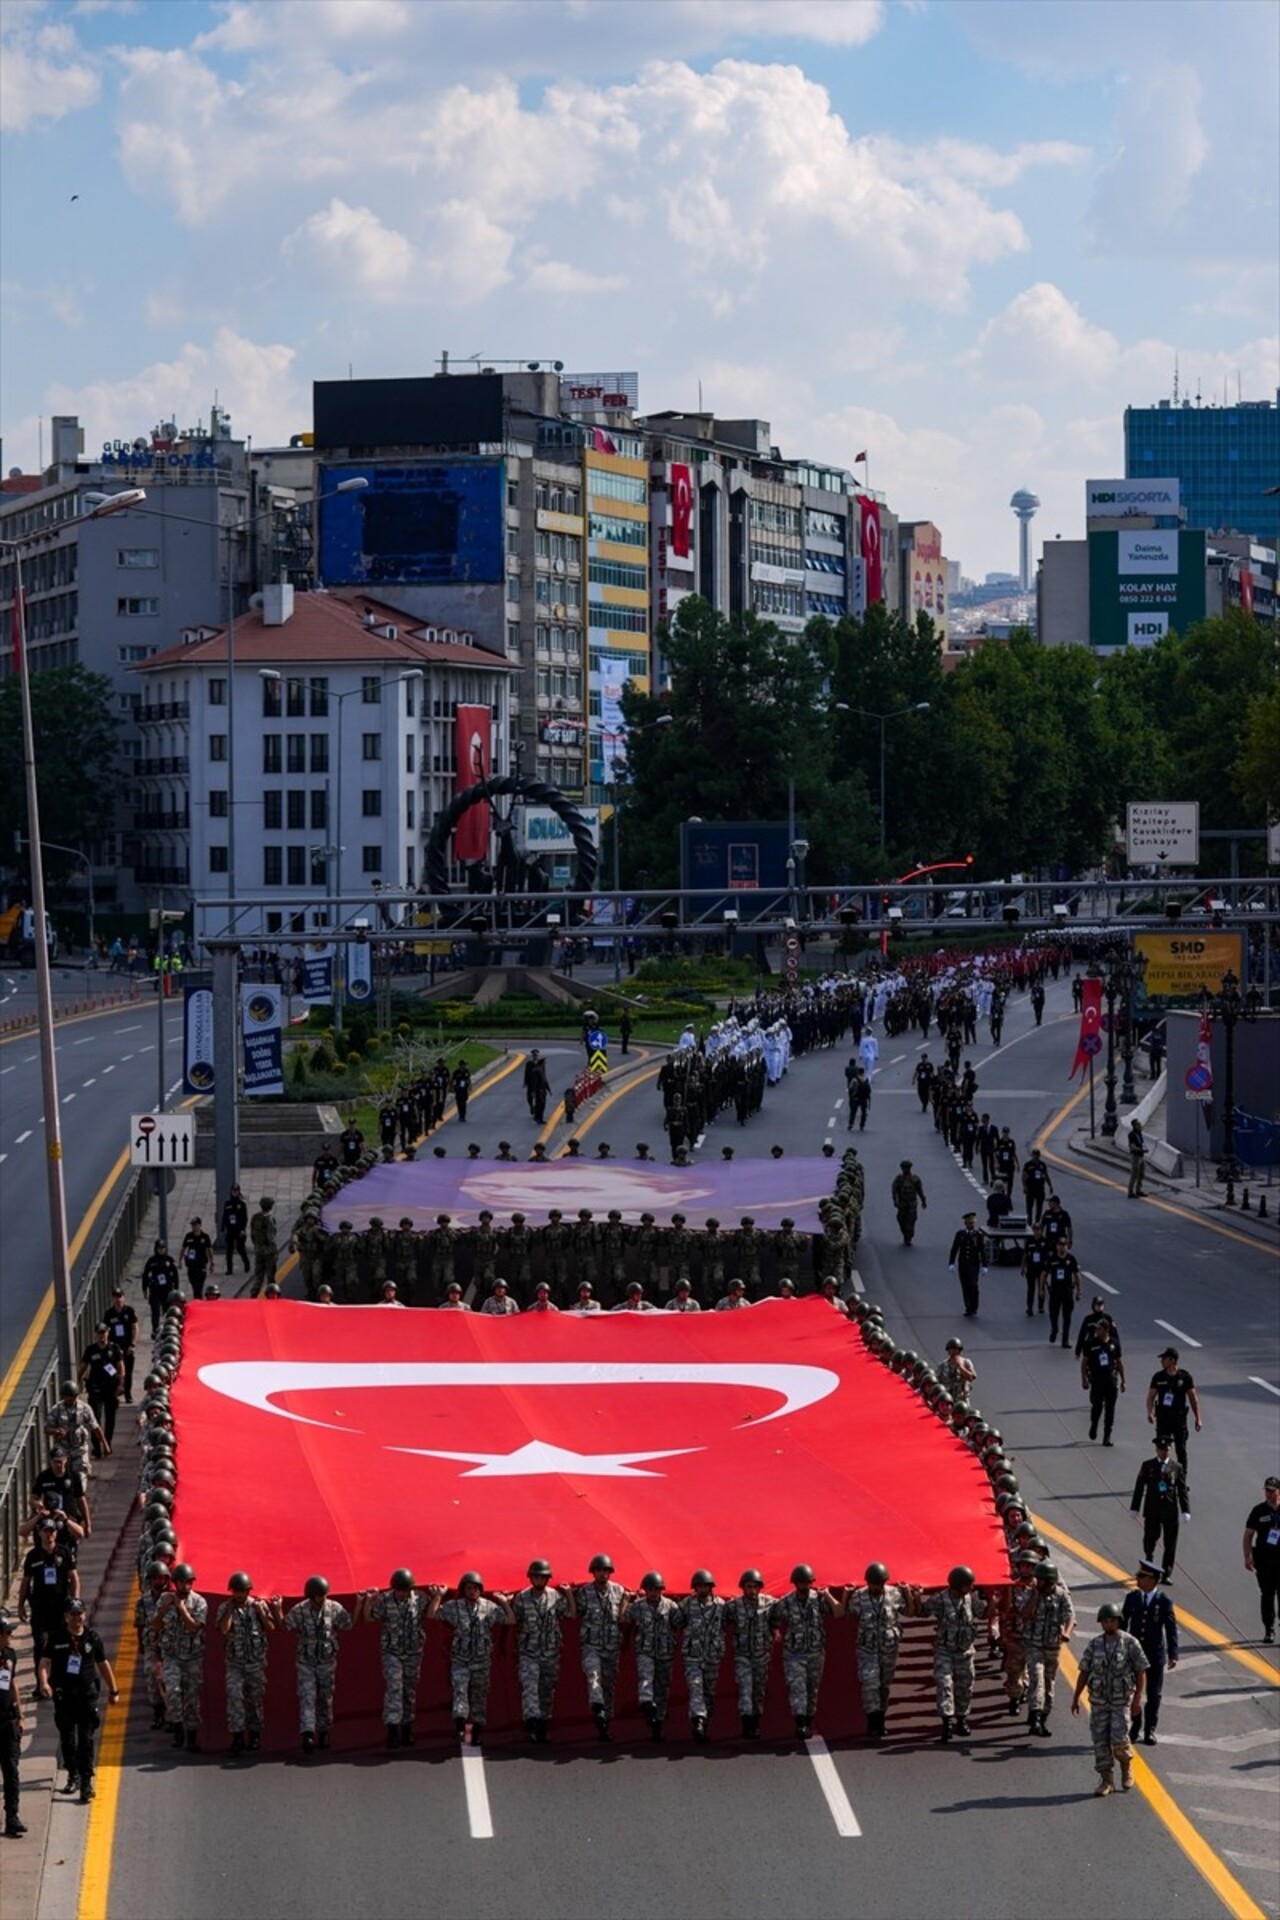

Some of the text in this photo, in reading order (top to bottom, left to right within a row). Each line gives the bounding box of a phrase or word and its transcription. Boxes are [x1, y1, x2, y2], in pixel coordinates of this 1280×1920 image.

[569, 386, 628, 407] TEST FEN
[1091, 492, 1115, 504] HDI
[657, 526, 667, 579] TEST
[1134, 544, 1162, 552] Daima
[1119, 583, 1177, 592] KOLAY HAT
[1134, 623, 1162, 635] HDI
[1132, 808, 1169, 817] Kızılay
[1132, 818, 1177, 827] Maltepe
[1132, 827, 1193, 836] Kavaklıdere
[1132, 837, 1178, 847] Çankaya
[1170, 941, 1205, 954] SMD
